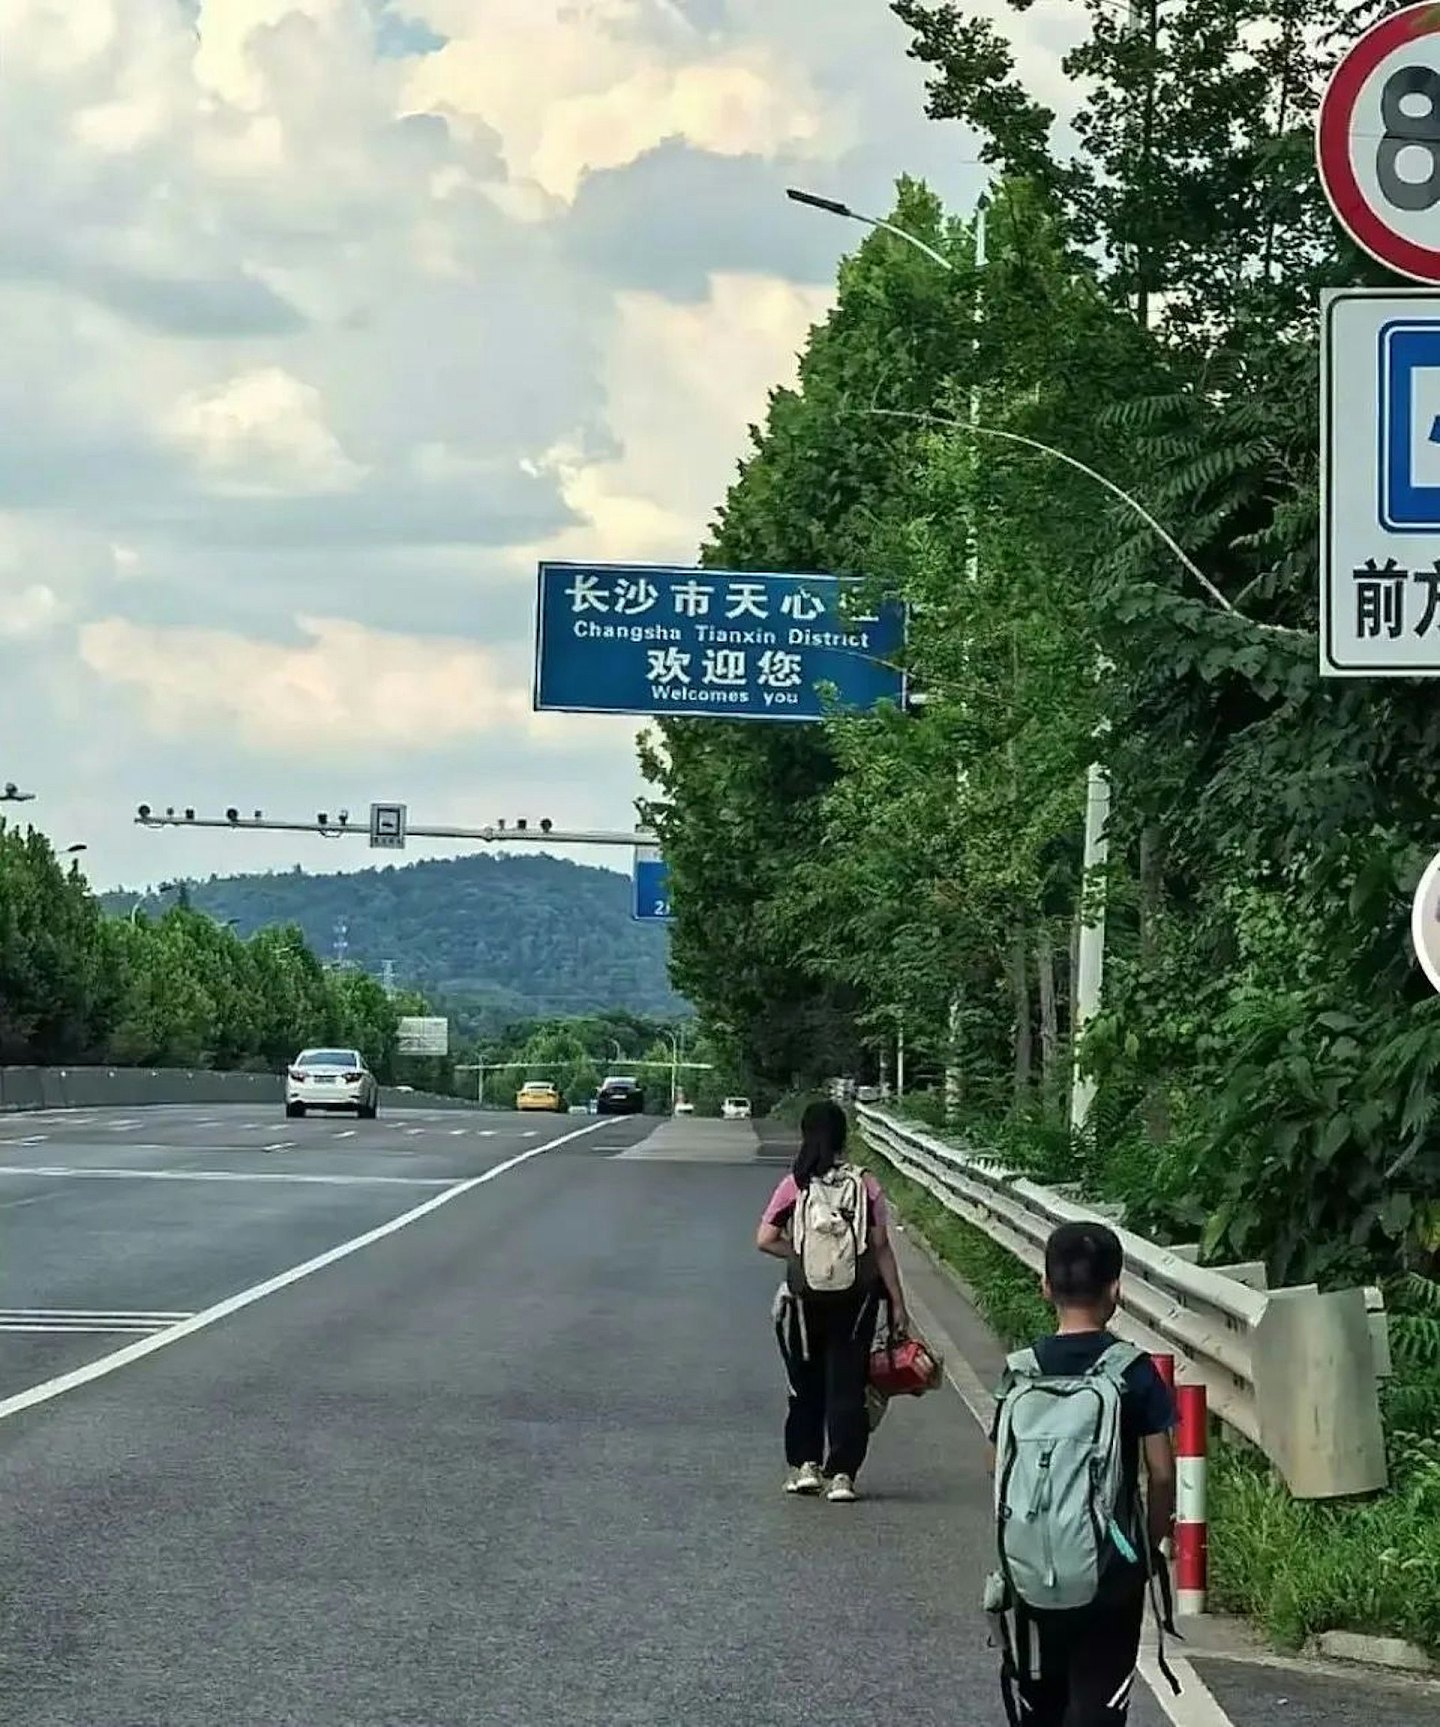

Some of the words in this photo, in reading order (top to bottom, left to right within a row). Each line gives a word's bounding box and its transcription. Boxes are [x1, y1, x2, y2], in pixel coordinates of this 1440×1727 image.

[1376, 66, 1440, 211] 8
[573, 620, 682, 642] Changsha
[695, 624, 776, 644] Tianxin
[788, 628, 869, 649] District
[645, 646, 802, 687] 欢迎您
[651, 685, 749, 703] Welcomes
[763, 692, 799, 706] you
